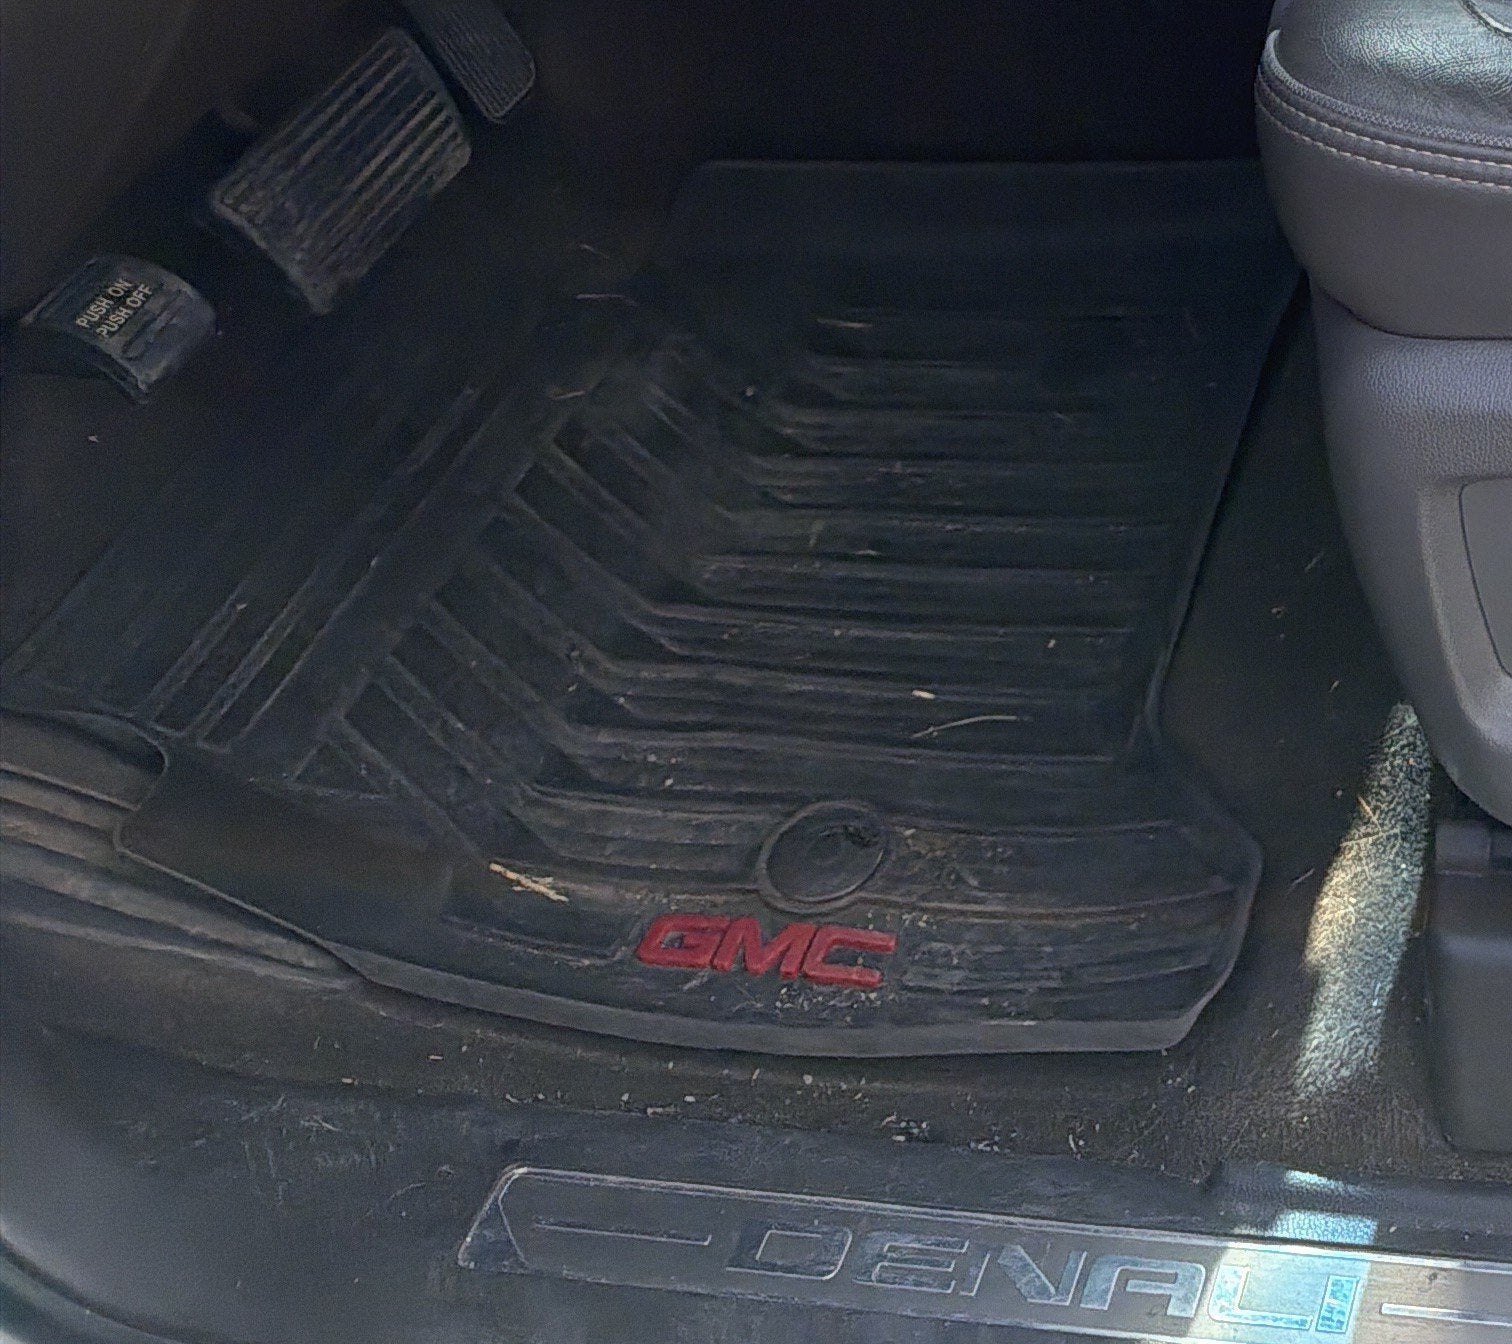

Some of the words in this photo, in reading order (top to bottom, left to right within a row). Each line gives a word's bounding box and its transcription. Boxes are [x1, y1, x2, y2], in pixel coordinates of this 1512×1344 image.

[75, 294, 115, 328] PUSH
[107, 277, 133, 297] ON
[95, 306, 134, 339] PUSH
[125, 283, 152, 308] OFF
[636, 913, 898, 989] GMC
[725, 1220, 1361, 1334] DENALI
